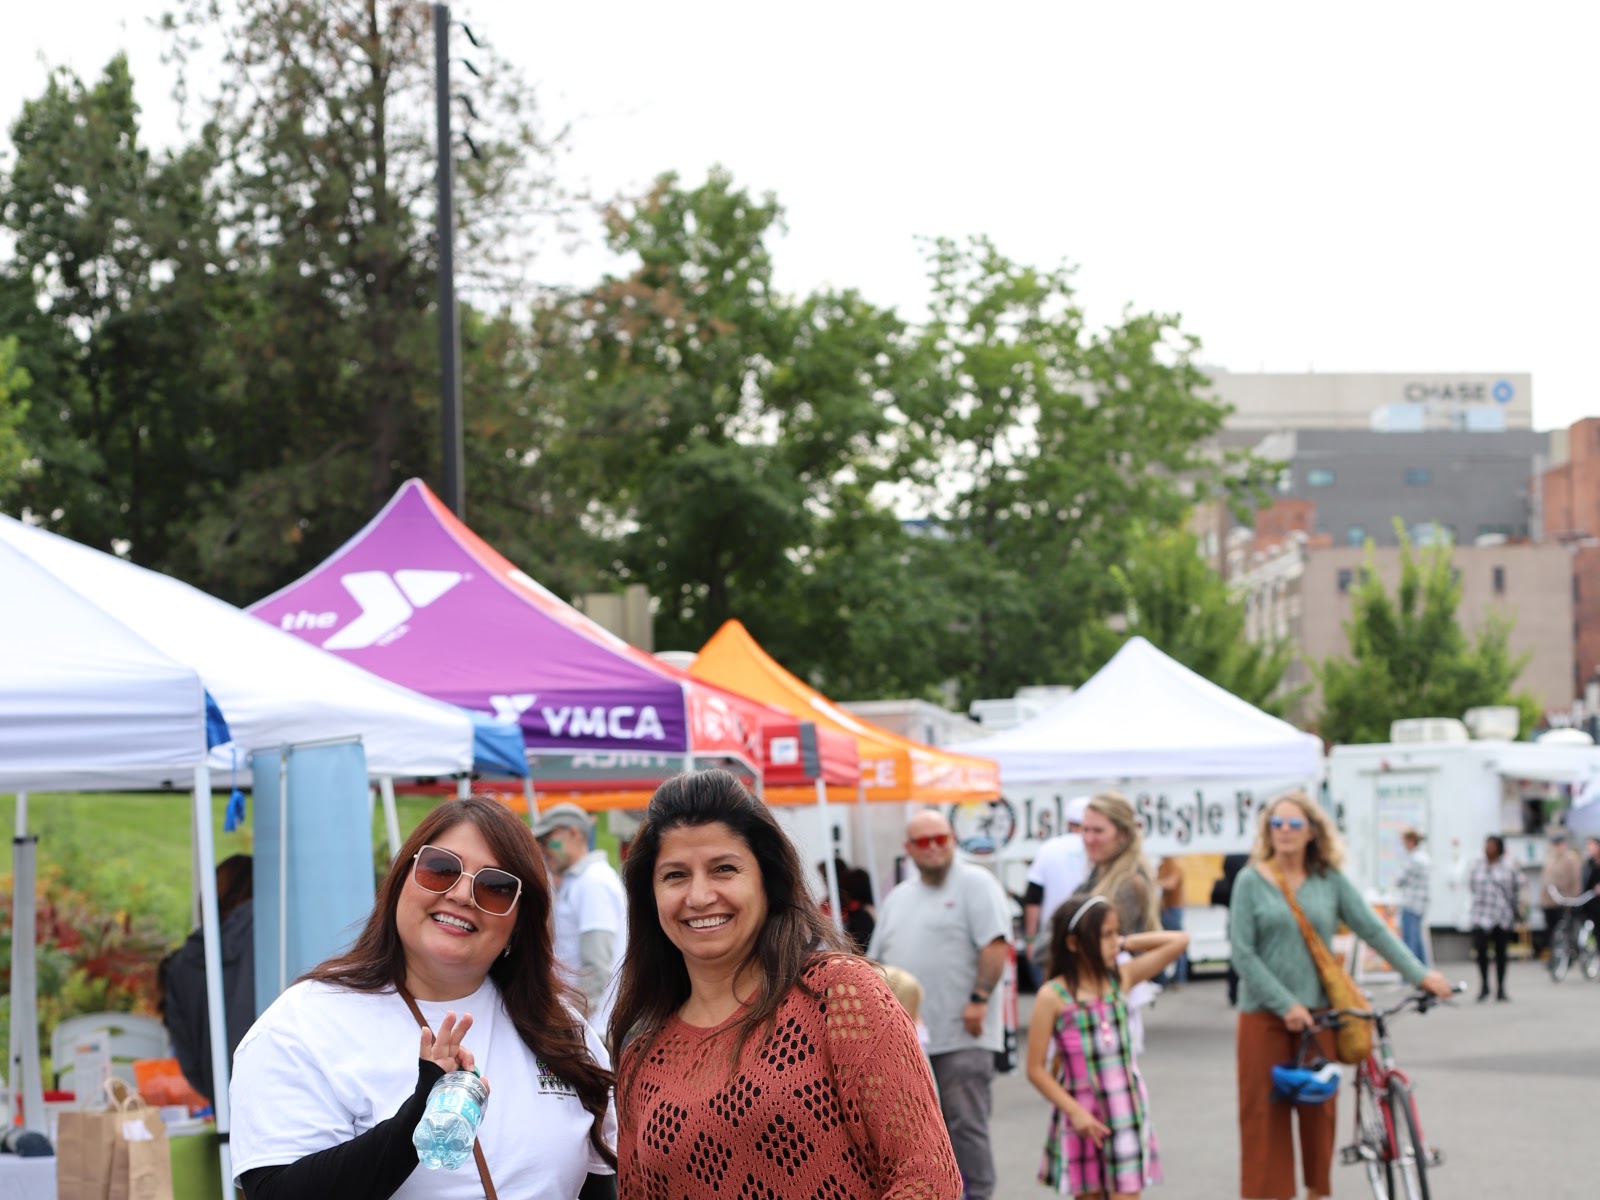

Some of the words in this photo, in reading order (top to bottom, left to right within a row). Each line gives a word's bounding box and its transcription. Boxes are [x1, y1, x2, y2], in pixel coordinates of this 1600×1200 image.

[1405, 381, 1486, 402] CHASE
[281, 611, 339, 631] the
[542, 704, 665, 740] YMCA
[1136, 789, 1223, 844] Style
